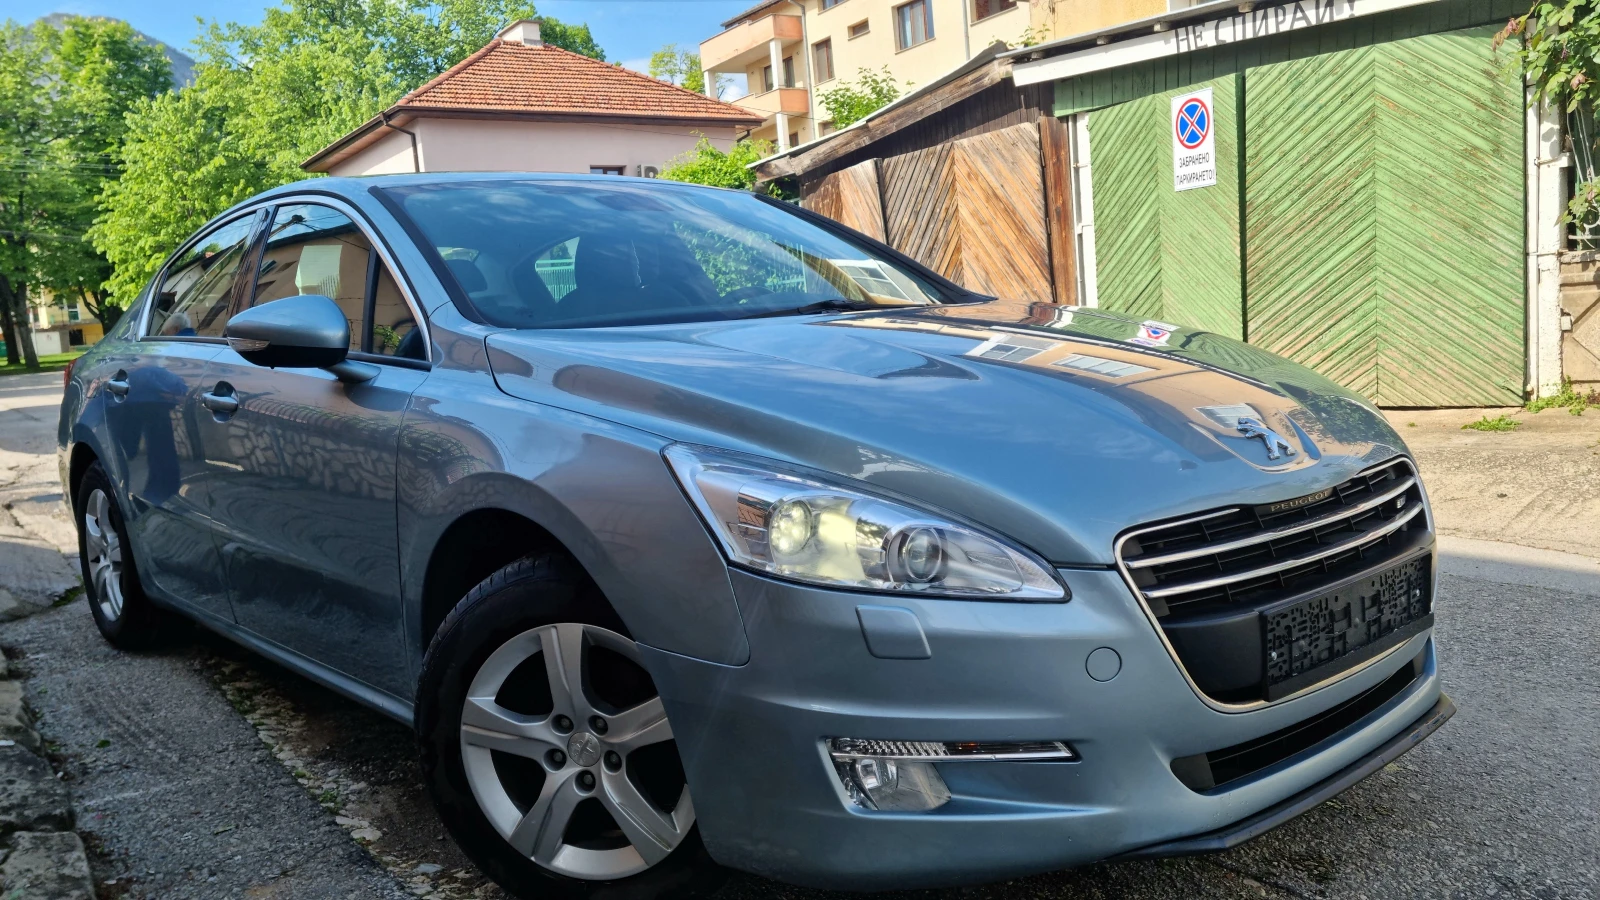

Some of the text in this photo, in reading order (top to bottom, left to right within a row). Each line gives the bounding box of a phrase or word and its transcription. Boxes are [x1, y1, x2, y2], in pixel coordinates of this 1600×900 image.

[1175, 22, 1208, 53] НЕ
[1178, 152, 1210, 168] ЗАБРАНЕНО
[1176, 169, 1215, 185] ПАРКИРАНЕТО!
[1271, 490, 1329, 512] PEUGEOT
